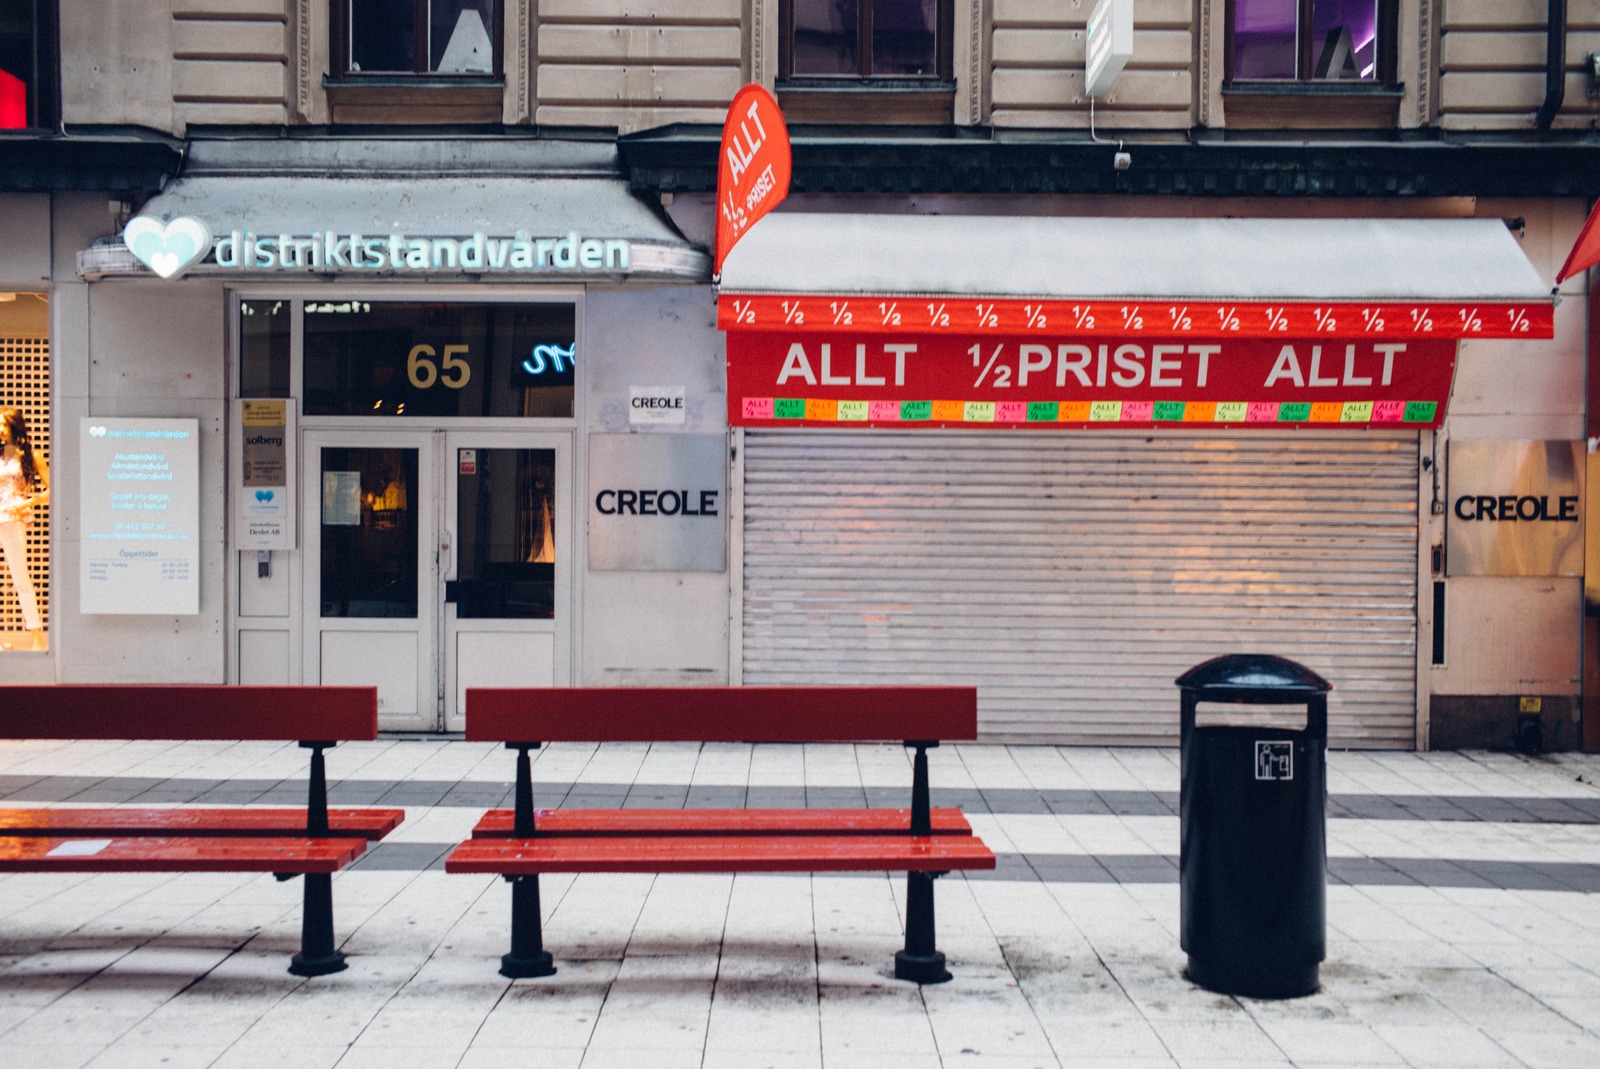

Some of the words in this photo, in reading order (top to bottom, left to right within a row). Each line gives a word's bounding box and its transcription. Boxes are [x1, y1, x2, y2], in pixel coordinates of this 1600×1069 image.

[727, 100, 758, 186] ALLT
[746, 163, 776, 211] PRISET
[215, 229, 630, 270] distriktstandvården
[407, 344, 471, 389] 65
[777, 343, 918, 386] ALLT
[1264, 344, 1407, 387] ALLT
[631, 397, 683, 409] CREOLE
[246, 435, 282, 448] solberg
[595, 489, 718, 516] CREOLE
[1454, 495, 1579, 521] CREOLE
